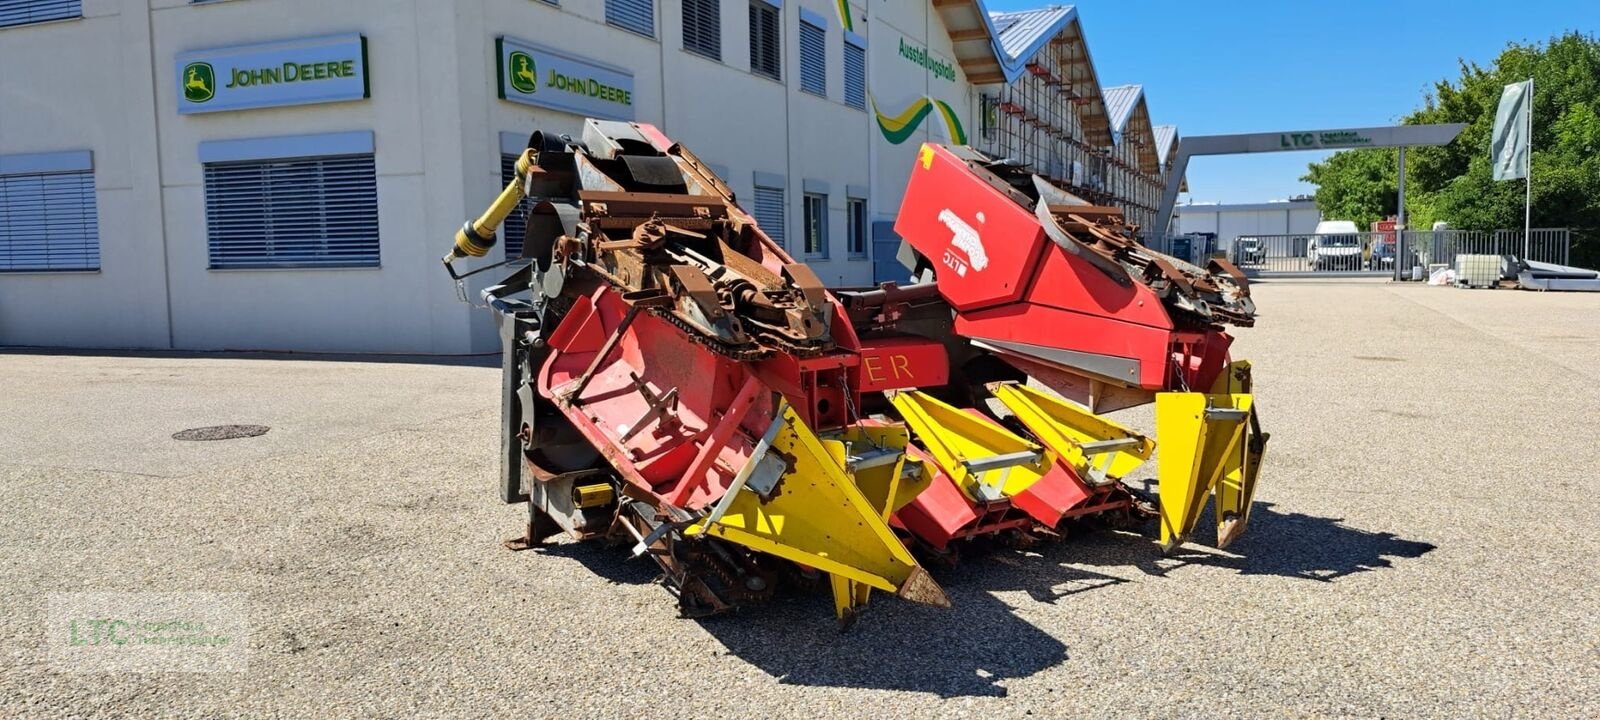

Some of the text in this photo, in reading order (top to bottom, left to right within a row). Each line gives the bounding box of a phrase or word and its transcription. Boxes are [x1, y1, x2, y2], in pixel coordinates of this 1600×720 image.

[898, 36, 956, 82] Ausstellungshalle
[225, 60, 354, 88] JOHN DEERE
[546, 69, 632, 106] JOHN DEERE
[1280, 132, 1314, 148] LTC
[942, 251, 960, 273] LTC
